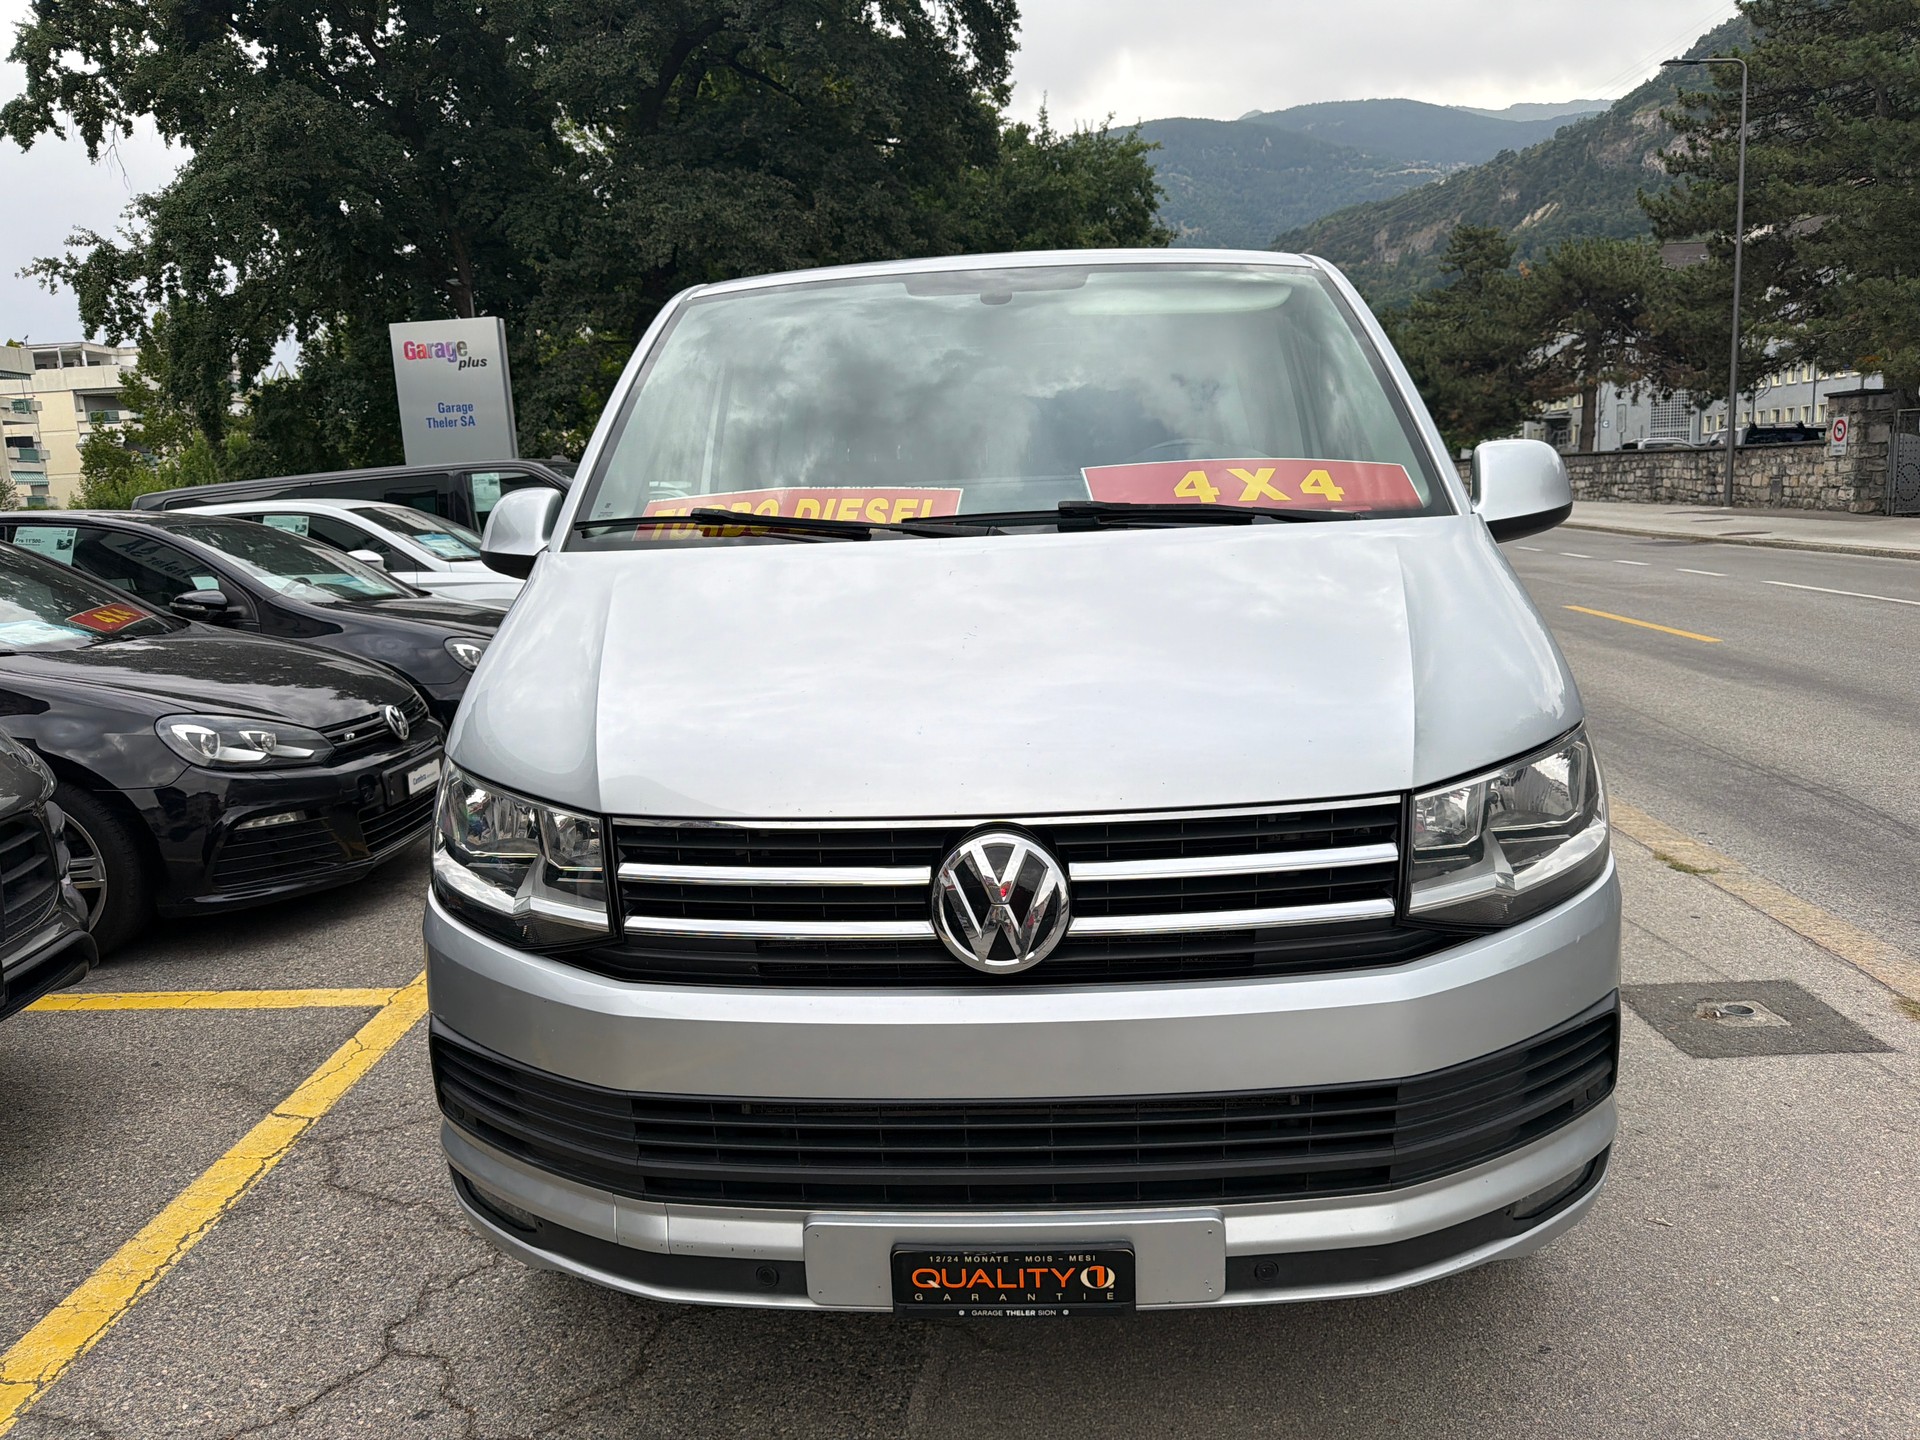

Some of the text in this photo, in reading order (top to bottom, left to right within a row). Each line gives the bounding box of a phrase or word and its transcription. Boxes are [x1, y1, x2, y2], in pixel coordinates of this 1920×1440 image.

[403, 340, 468, 363] Garage
[458, 357, 488, 371] plus
[437, 402, 474, 414] Garage
[426, 415, 476, 429] Theler SA
[929, 1255, 959, 1263] 12/24
[964, 1255, 1009, 1263] MONATE
[1025, 1255, 1053, 1263] MOIS
[1069, 1254, 1096, 1262] MESI
[911, 1266, 1076, 1289] QUALITY
[914, 1292, 1114, 1301] GARANTIE
